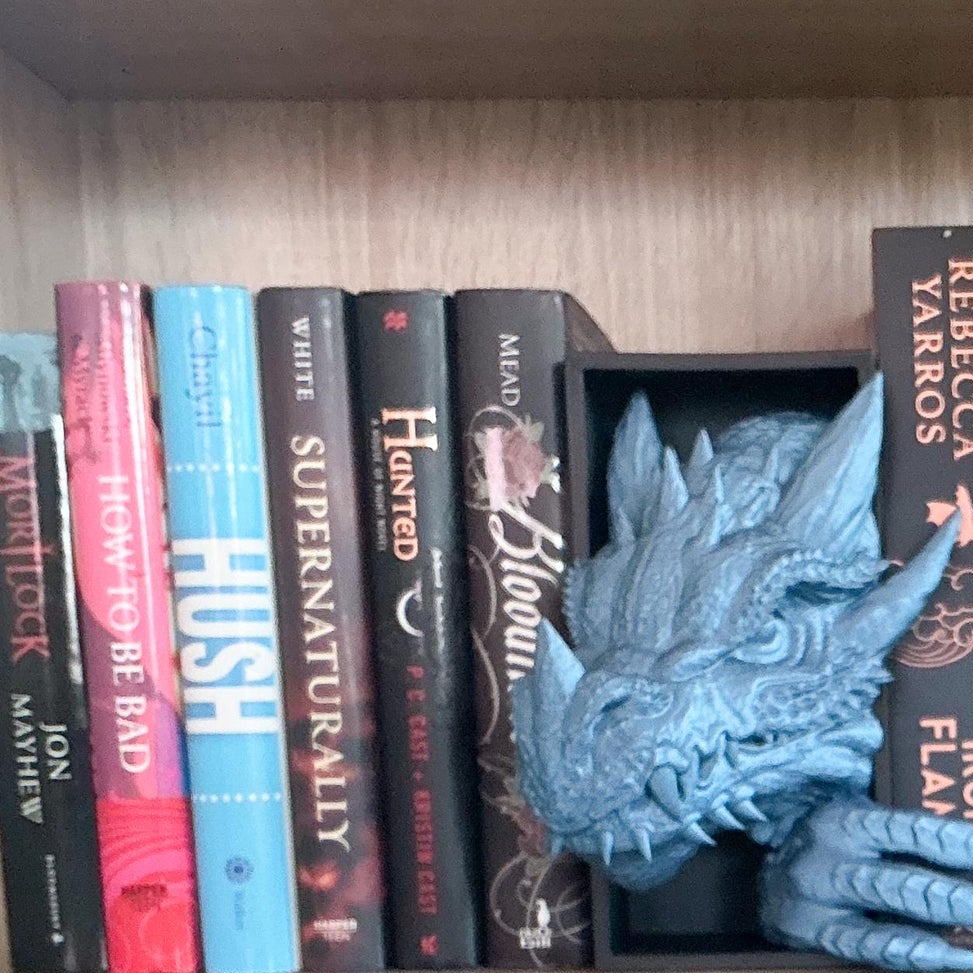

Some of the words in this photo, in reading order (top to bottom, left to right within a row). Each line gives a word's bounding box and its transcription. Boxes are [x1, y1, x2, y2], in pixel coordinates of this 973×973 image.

[291, 317, 316, 402] WHITE
[499, 333, 521, 407] MEAD
[912, 274, 946, 445] YARROS
[0, 456, 54, 664] MORTLOCK
[97, 474, 137, 571] HOW
[106, 576, 140, 633] TO
[172, 538, 281, 735] HUSH
[290, 434, 350, 852] SUPERNATURALLY
[110, 641, 145, 686] BE
[10, 692, 43, 824] MAYHEW
[39, 722, 72, 782] JON
[115, 694, 151, 775] BAD
